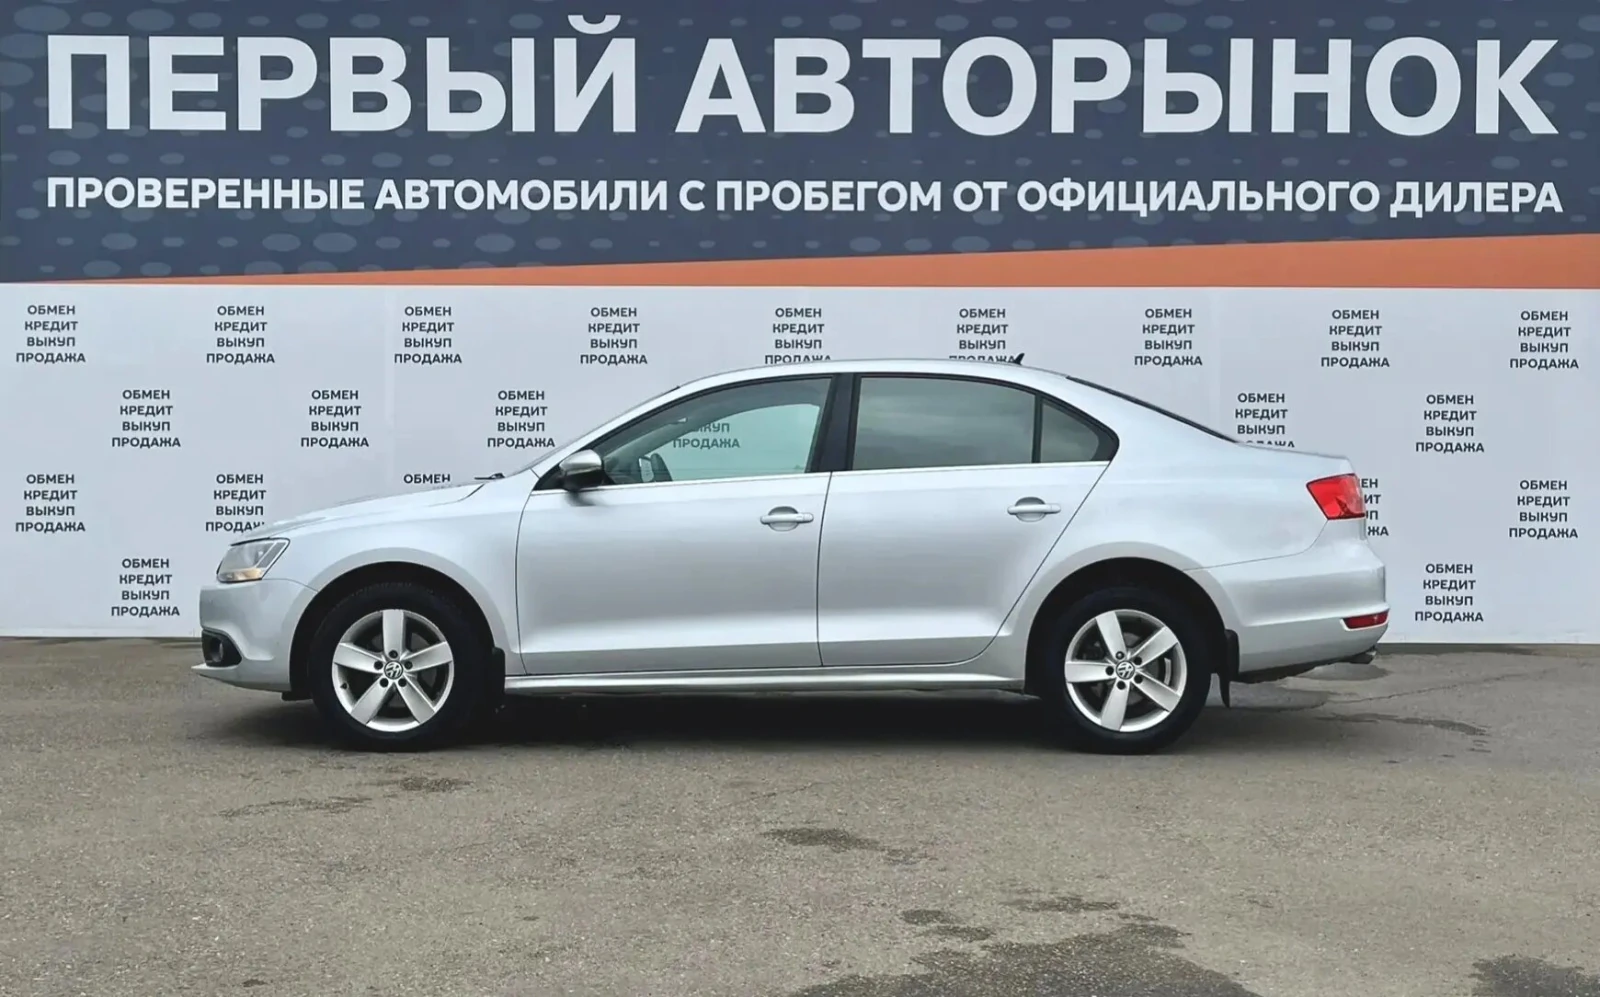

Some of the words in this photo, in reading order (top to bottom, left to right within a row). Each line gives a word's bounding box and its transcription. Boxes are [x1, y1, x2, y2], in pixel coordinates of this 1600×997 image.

[47, 14, 636, 133] ПЕРВЫЙ
[675, 36, 1559, 136] АВТОРЫНОК
[47, 177, 365, 210] ПРОВЕРЕННЫЕ
[374, 179, 668, 211] АВТОМОБИЛИ
[679, 180, 706, 211] С
[716, 180, 941, 212] ПРОБЕГОМ
[953, 180, 1008, 212] ОТ
[1017, 177, 1380, 218] ОФИЦИАЛЬНОГО
[1389, 181, 1564, 218] ДИЛЕРА
[27, 304, 76, 315] ОБМЕН
[217, 305, 265, 316] ОБМЕН
[404, 306, 452, 317] ОБМЕН
[590, 307, 637, 318] ОБМЕН
[774, 307, 822, 318] ОБМЕН
[959, 308, 1006, 319] ОБМЕН
[1144, 308, 1192, 319] ОБМЕН
[1331, 309, 1380, 320] ОБМЕН
[1520, 310, 1568, 321] ОБМЕН
[24, 320, 79, 333] КРЕДИТ
[214, 321, 268, 334] КРЕДИТ
[402, 322, 455, 334] КРЕДИТ
[588, 322, 641, 335] КРЕДИТ
[772, 323, 825, 335] КРЕДИТ
[956, 324, 1009, 336] КРЕДИТ
[1142, 324, 1196, 336] КРЕДИТ
[1329, 325, 1383, 338] КРЕДИТ
[1517, 326, 1572, 339] КРЕДИТ
[26, 336, 76, 347] ВЫКУП
[216, 337, 265, 348] ВЫКУП
[404, 337, 452, 348] ВЫКУП
[590, 338, 638, 349] ВЫКУП
[774, 339, 822, 349] ВЫКУП
[959, 339, 1006, 350] ВЫКУП
[1144, 339, 1193, 350] ВЫКУП
[1331, 341, 1380, 352] ВЫКУП
[1520, 342, 1569, 353] ВЫКУП
[16, 352, 86, 365] ПРОДАЖА
[206, 353, 276, 365] ПРОДАЖА
[394, 353, 463, 366] ПРОДАЖА
[580, 354, 648, 366] ПРОДАЖА
[1134, 355, 1203, 368] ПРОДАЖА
[1321, 356, 1390, 369] ПРОДАЖА
[1509, 358, 1579, 371] ПРОДАЖА
[122, 389, 170, 400] ОБМЕН
[311, 389, 359, 400] ОБМЕН
[497, 390, 545, 401] ОБМЕН
[1237, 392, 1285, 403] ОБМЕН
[1426, 394, 1474, 405] ОБМЕН
[119, 405, 174, 418] КРЕДИТ
[308, 405, 362, 418] КРЕДИТ
[495, 406, 548, 418] КРЕДИТ
[1235, 408, 1289, 421] КРЕДИТ
[1423, 410, 1477, 423] КРЕДИТ
[122, 421, 171, 432] ВЫКУП
[311, 421, 359, 432] ВЫКУП
[497, 421, 545, 432] ВЫКУП
[1237, 424, 1286, 435] ВЫКУП
[1425, 426, 1474, 437] ВЫКУП
[111, 437, 181, 449] ПРОДАЖА
[300, 437, 370, 449] ПРОДАЖА
[487, 437, 556, 450] ПРОДАЖА
[672, 438, 741, 450] ПРОДАЖА
[1415, 441, 1485, 454] ПРОДАЖА
[26, 474, 75, 485] ОБМЕН
[216, 473, 264, 484] ОБМЕН
[403, 473, 451, 484] ОБМЕН
[1519, 479, 1568, 491] ОБМЕН
[23, 489, 78, 502] КРЕДИТ
[213, 489, 267, 502] КРЕДИТ
[1517, 495, 1571, 508] КРЕДИТ
[26, 505, 75, 516] ВЫКУП
[215, 505, 264, 516] ВЫКУП
[1519, 511, 1568, 523] ВЫКУП
[15, 521, 86, 534] ПРОДАЖА
[1508, 527, 1579, 540] ПРОДАЖА
[121, 558, 170, 569] ОБМЕН
[1425, 563, 1473, 574] ОБМЕН
[119, 574, 173, 586] КРЕДИТ
[1422, 579, 1477, 592] КРЕДИТ
[121, 590, 170, 601] ВЫКУП
[1425, 595, 1474, 606] ВЫКУП
[111, 606, 181, 618] ПРОДАЖА
[1414, 611, 1484, 624] ПРОДАЖА
